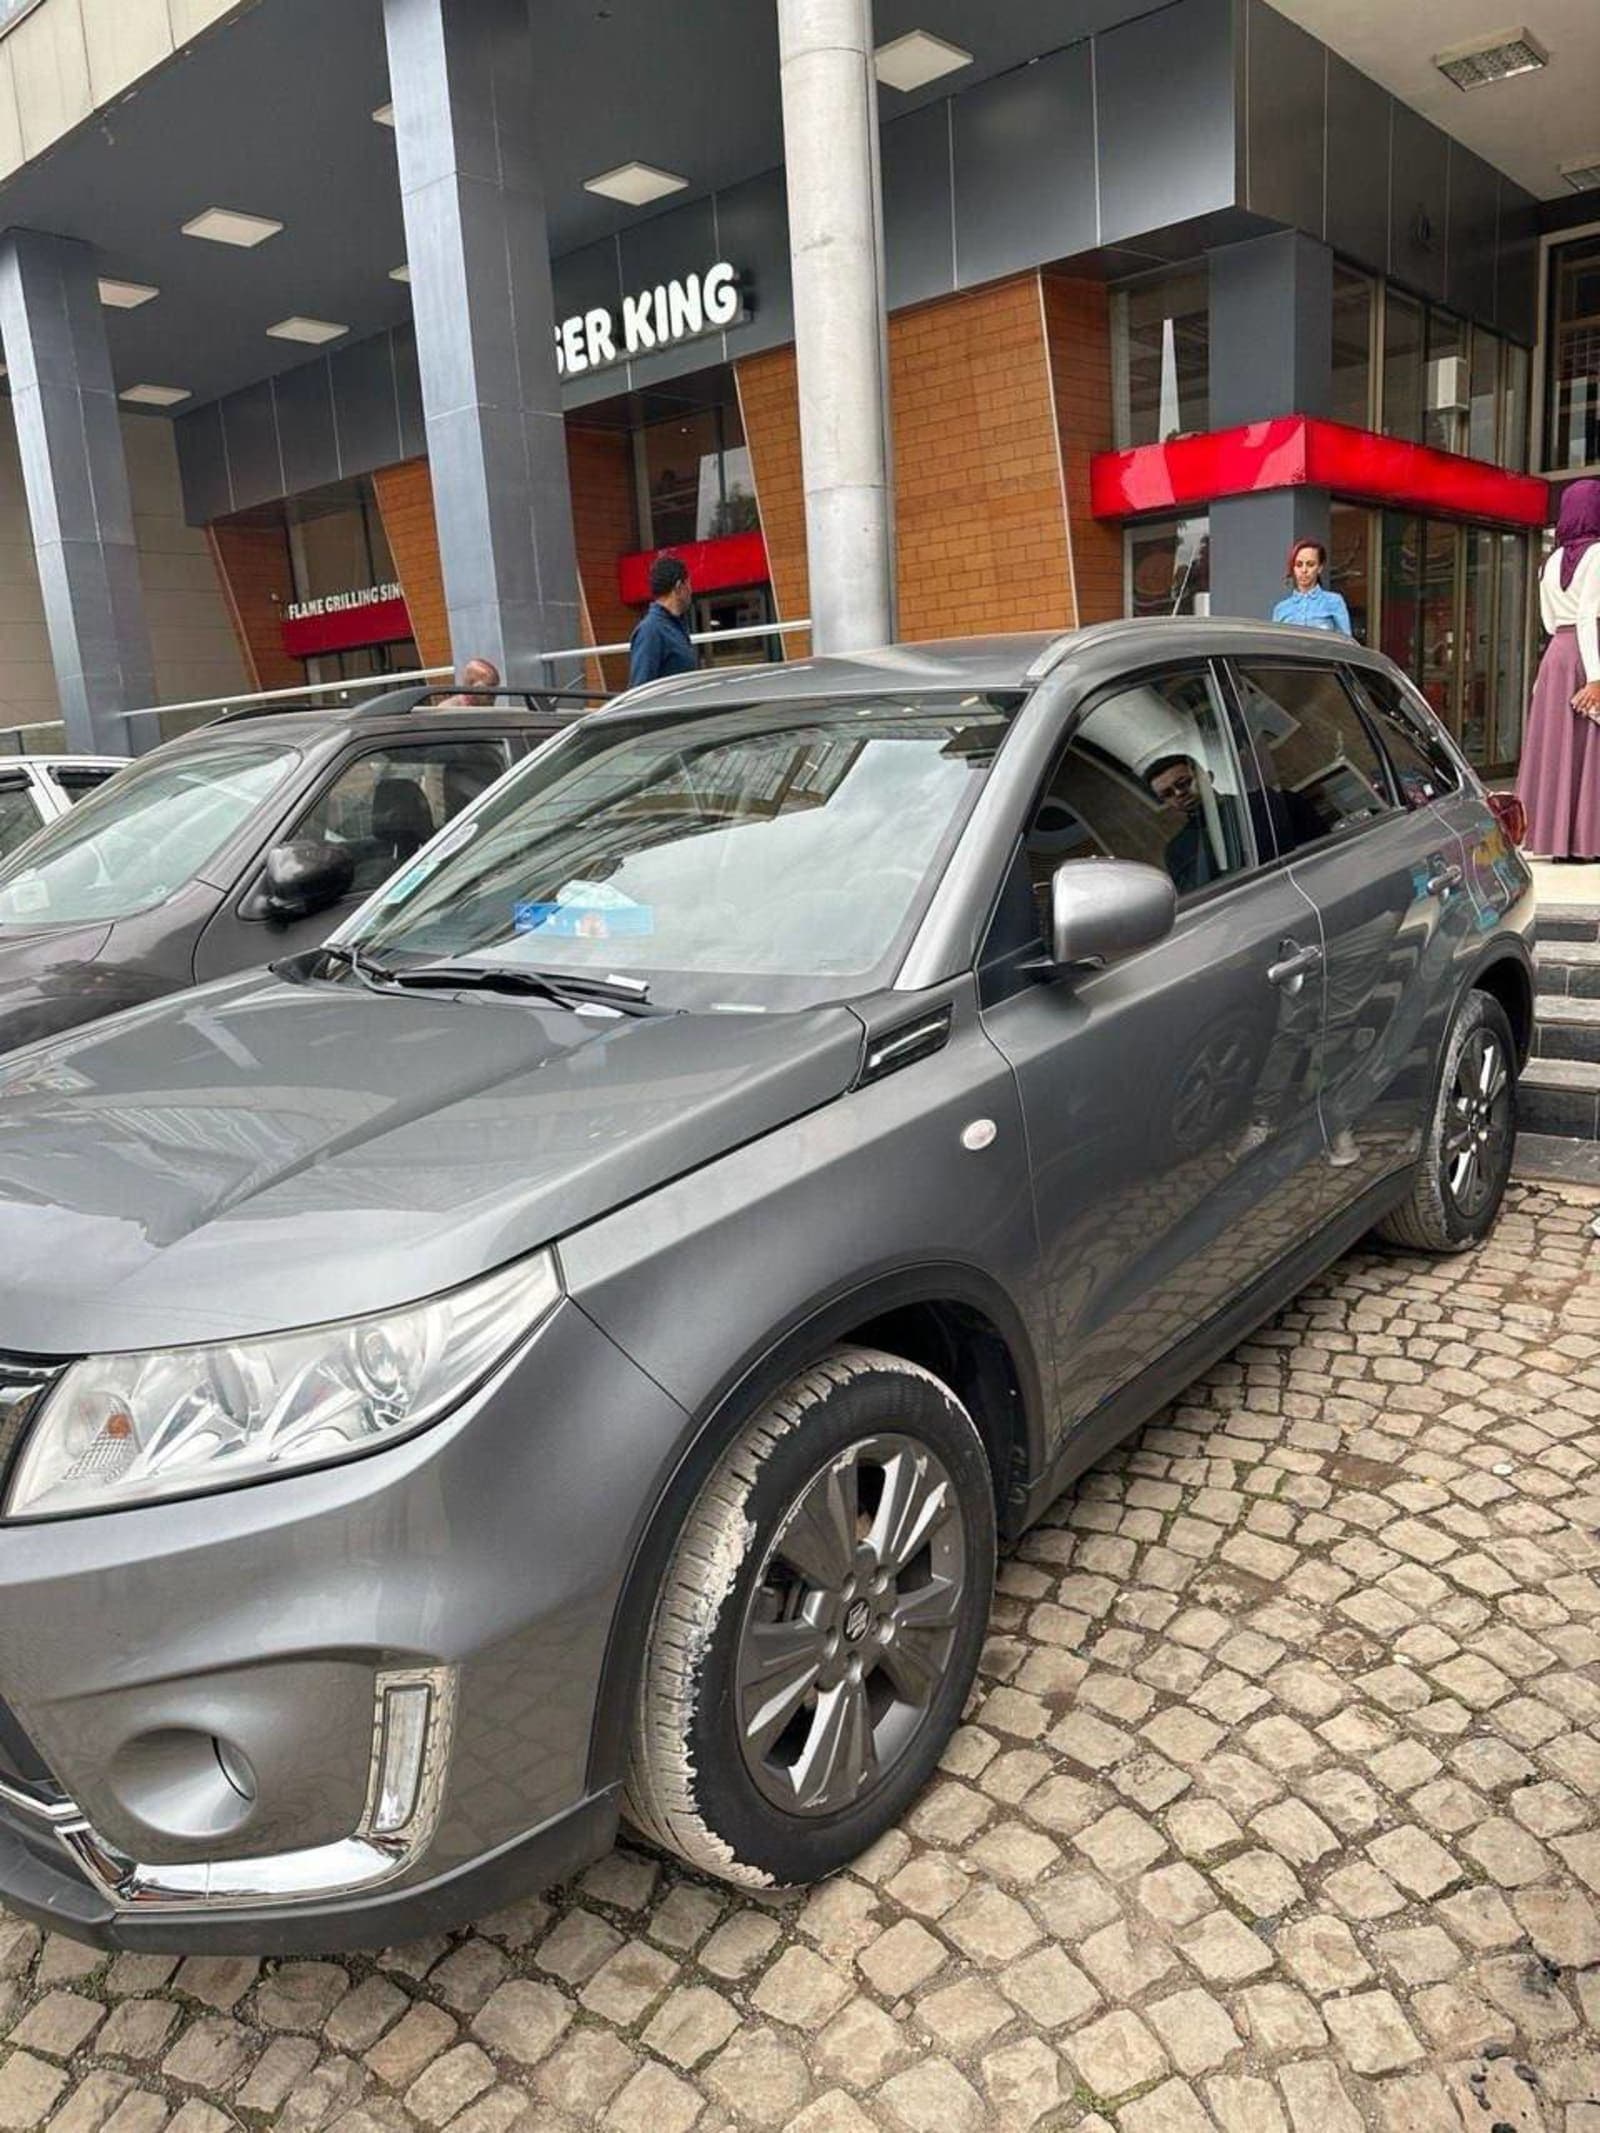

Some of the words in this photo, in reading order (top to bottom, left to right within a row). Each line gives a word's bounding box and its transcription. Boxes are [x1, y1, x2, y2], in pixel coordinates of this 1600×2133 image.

[623, 262, 738, 353] KING
[288, 599, 325, 620] FLAME
[325, 586, 379, 612] GRILLING
